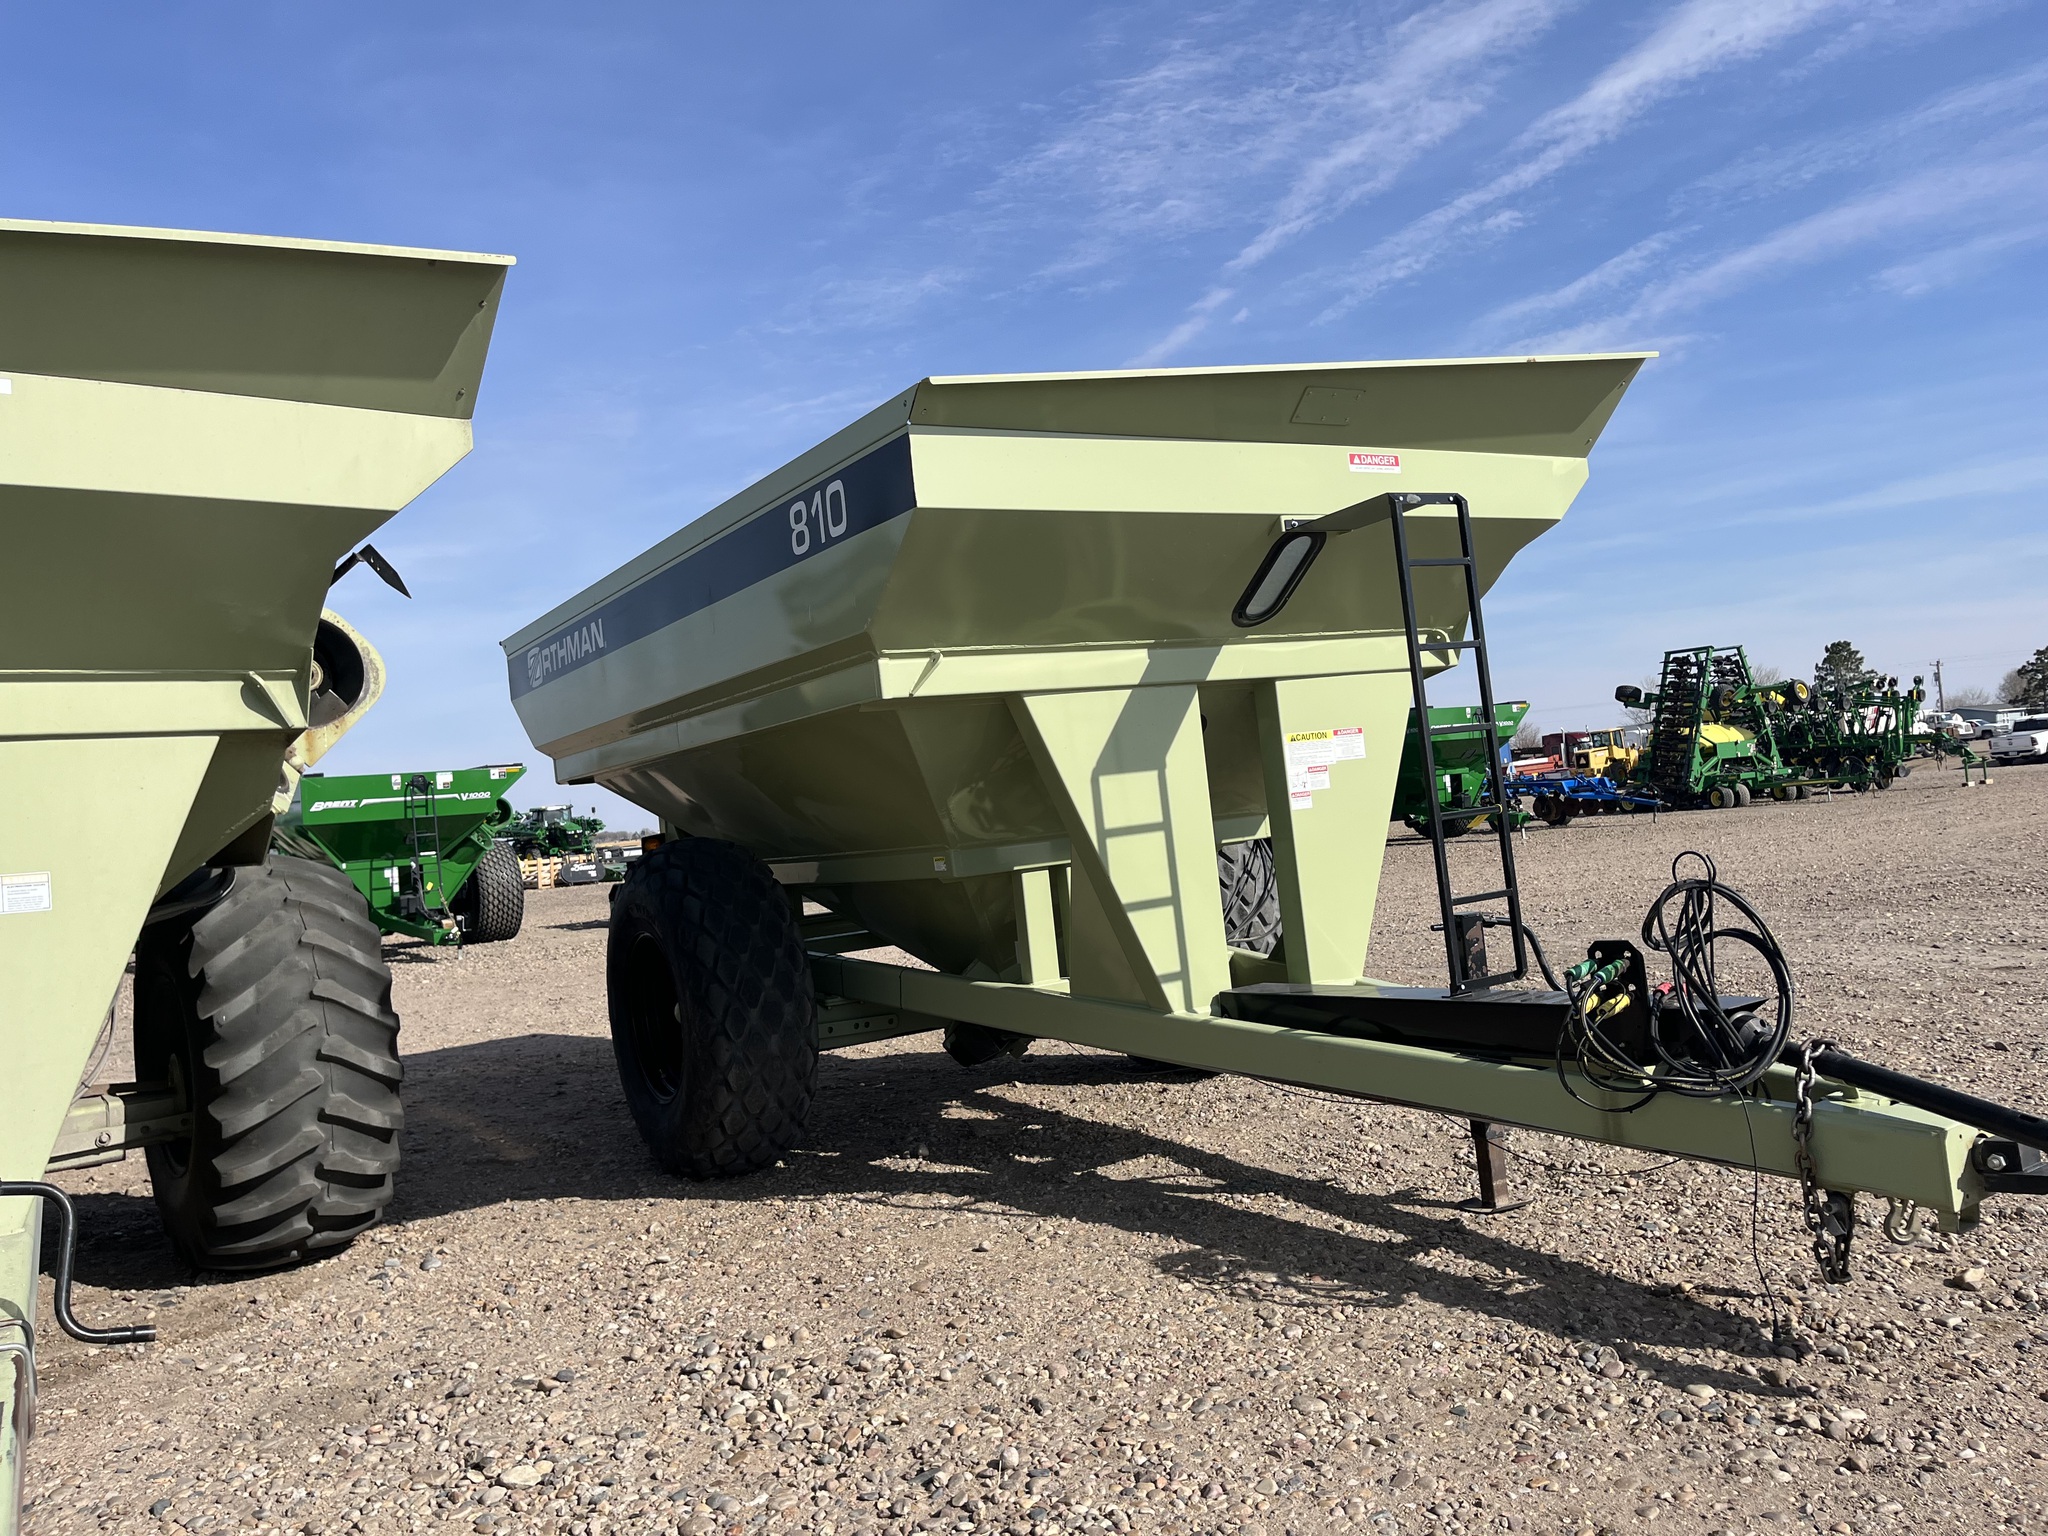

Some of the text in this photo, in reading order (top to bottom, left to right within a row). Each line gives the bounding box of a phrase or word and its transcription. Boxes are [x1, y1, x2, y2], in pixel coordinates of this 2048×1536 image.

[1361, 455, 1396, 466] DANGER
[789, 479, 847, 556] 810
[1295, 731, 1328, 742] CAUTION
[460, 791, 491, 801] V1000
[309, 799, 359, 812] BRENT
